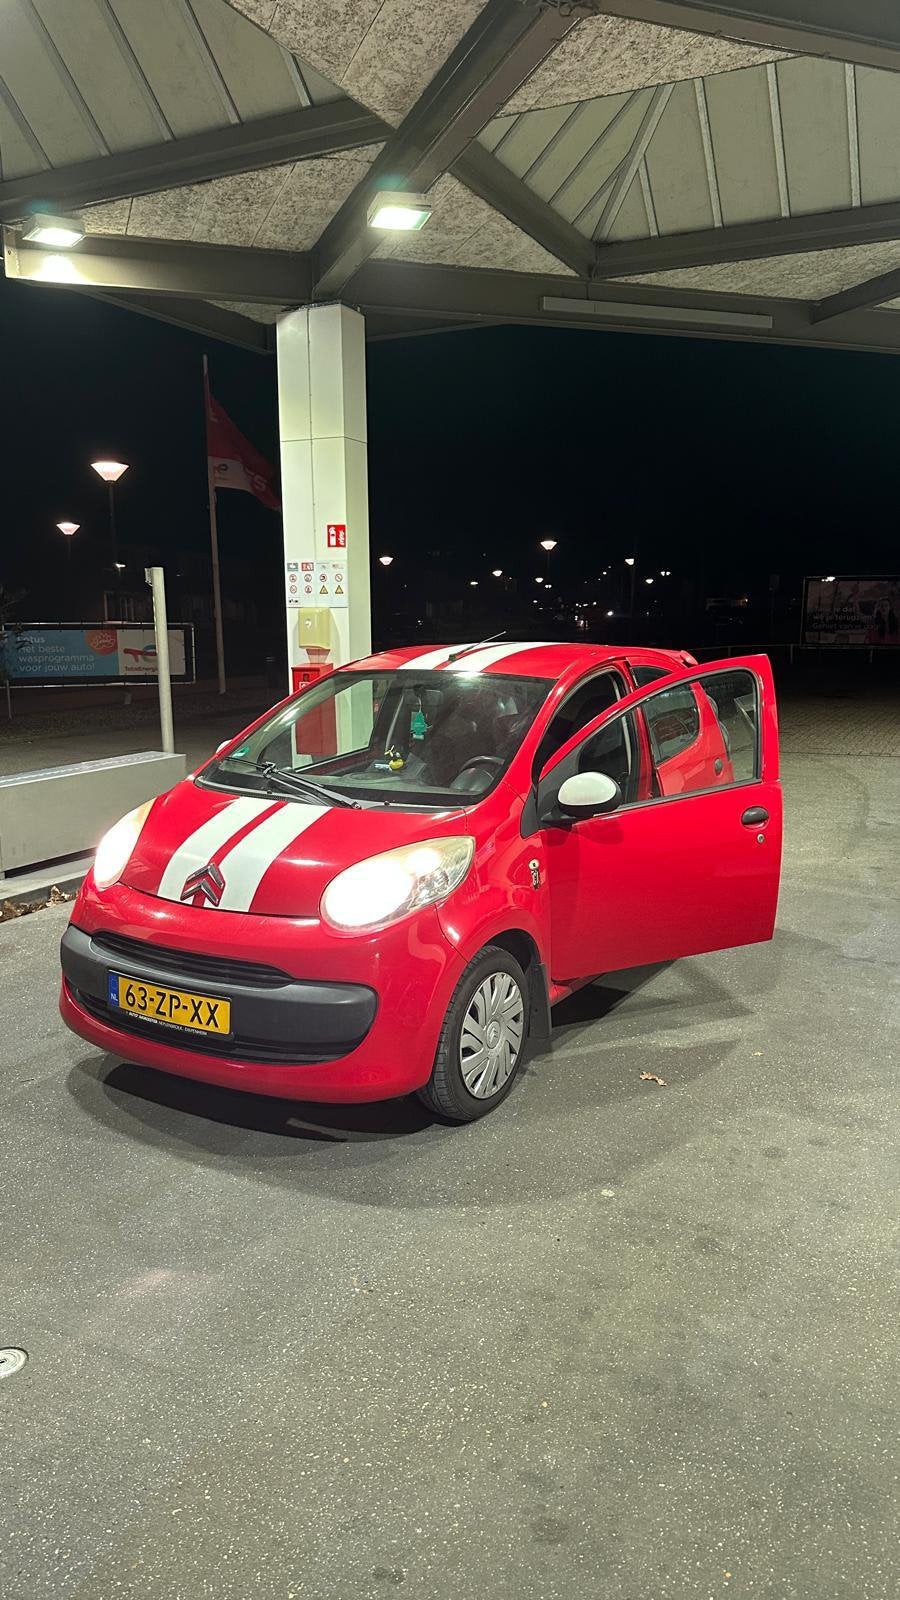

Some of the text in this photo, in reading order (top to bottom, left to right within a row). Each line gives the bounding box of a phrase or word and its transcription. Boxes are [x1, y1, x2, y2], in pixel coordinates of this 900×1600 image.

[38, 645, 65, 653] beste
[18, 655, 95, 664] wasprogramma
[44, 664, 69, 673] jouw
[110, 993, 118, 1001] NL
[125, 984, 219, 1029] 63-ZP-XX
